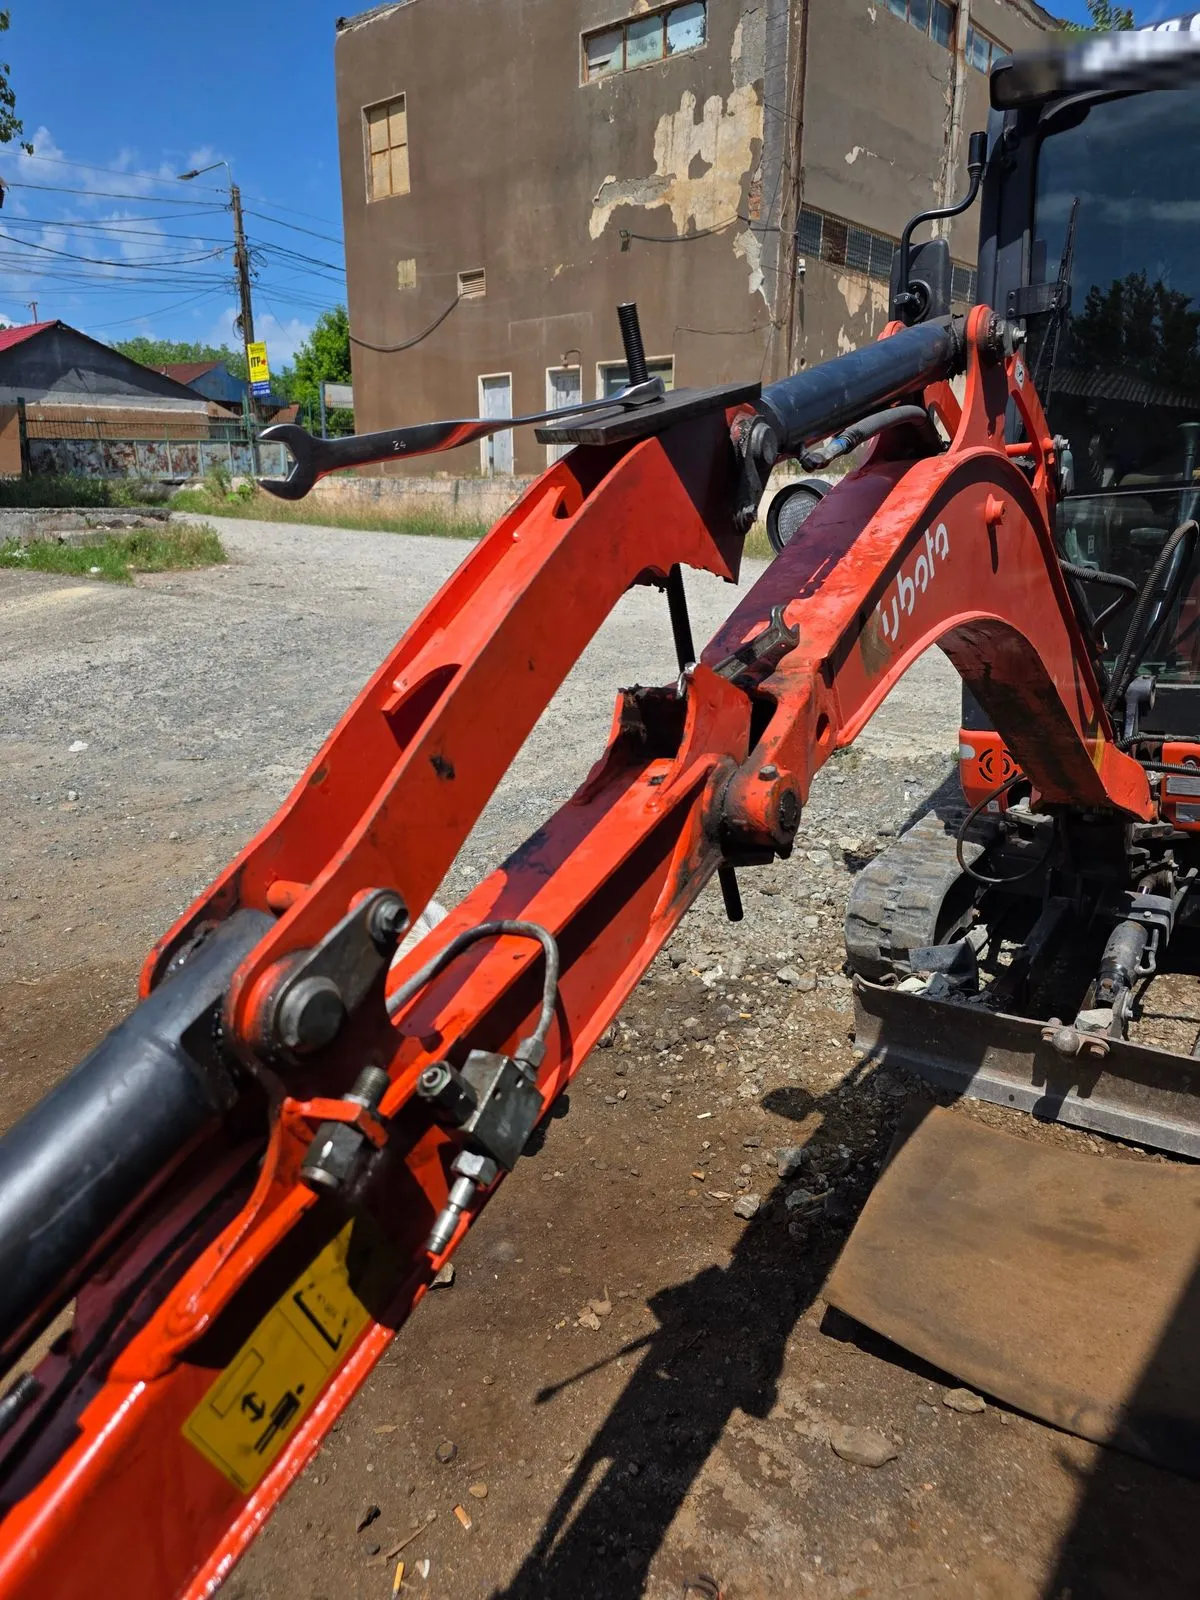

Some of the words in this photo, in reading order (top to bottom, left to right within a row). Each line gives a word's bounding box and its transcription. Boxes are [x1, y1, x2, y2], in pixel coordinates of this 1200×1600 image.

[251, 356, 261, 368] ITP
[392, 440, 407, 451] 24
[876, 523, 949, 641] ubota
